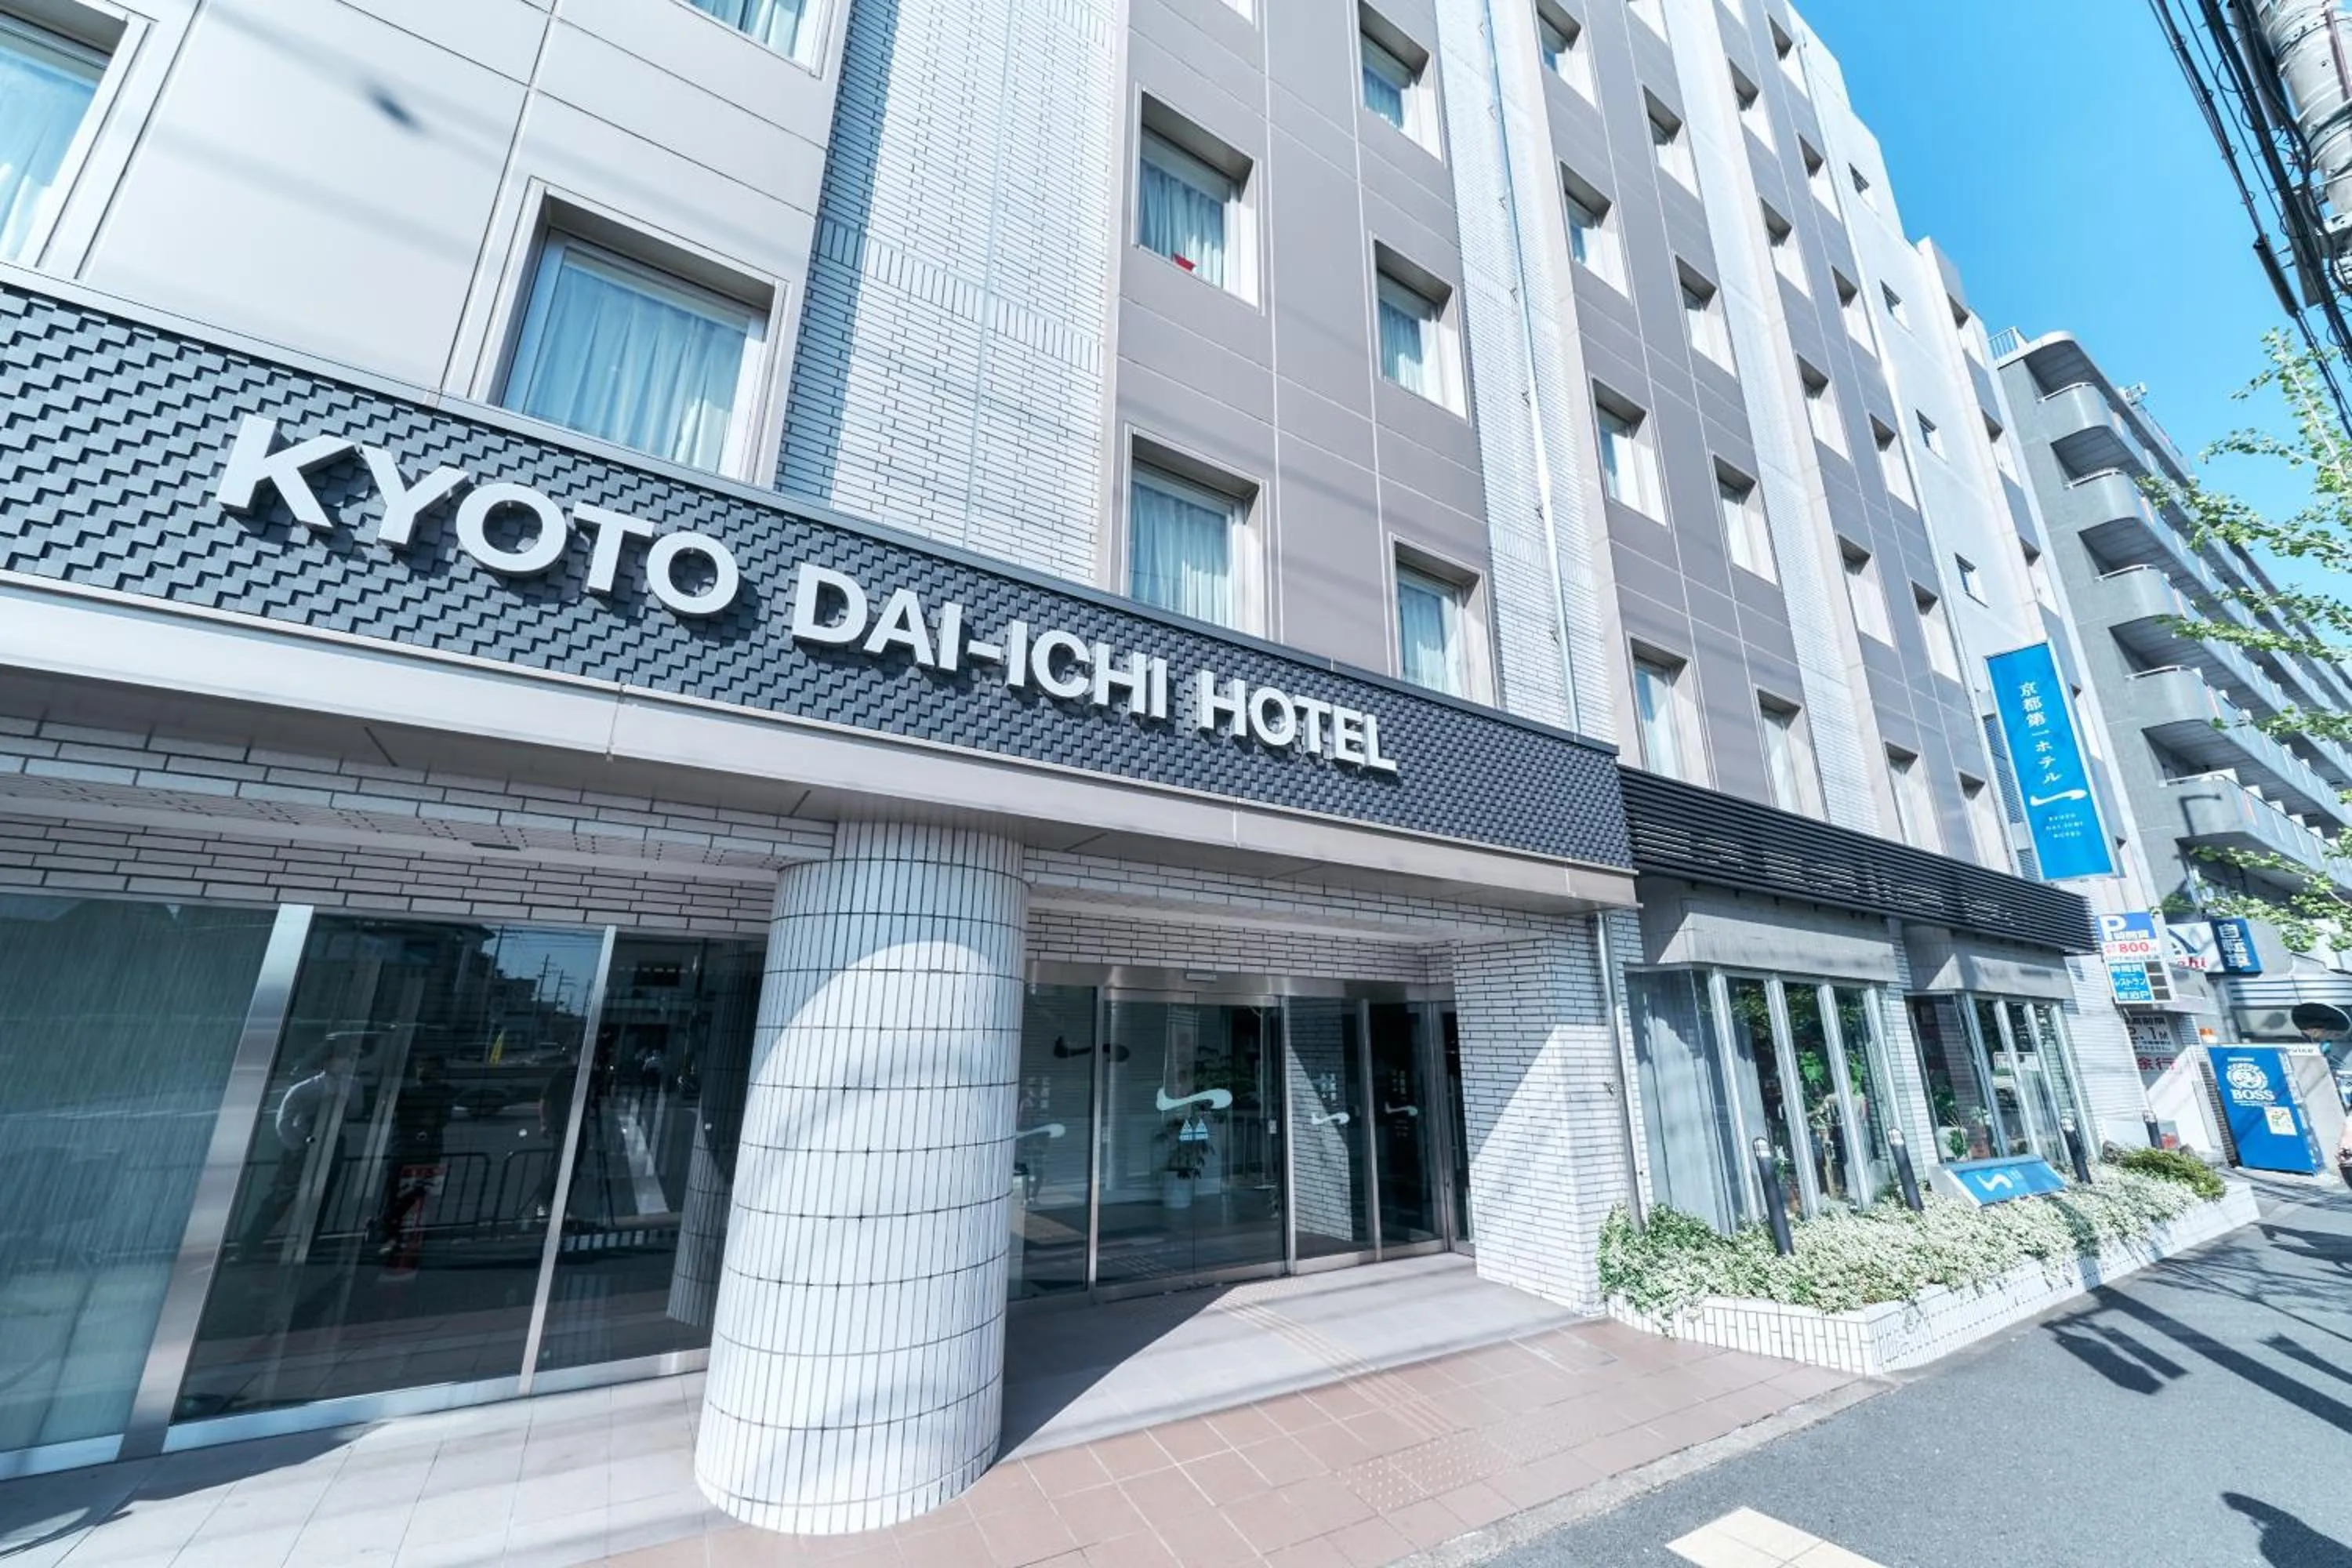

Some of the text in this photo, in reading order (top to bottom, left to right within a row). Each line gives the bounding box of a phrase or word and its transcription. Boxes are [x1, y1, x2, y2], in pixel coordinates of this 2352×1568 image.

[215, 412, 1398, 773] KYOTO DAI-ICHI HOTEL
[2019, 681, 2063, 786] 京都第一ホテル
[2100, 915, 2127, 942] P
[2229, 1088, 2276, 1102] BOSS
